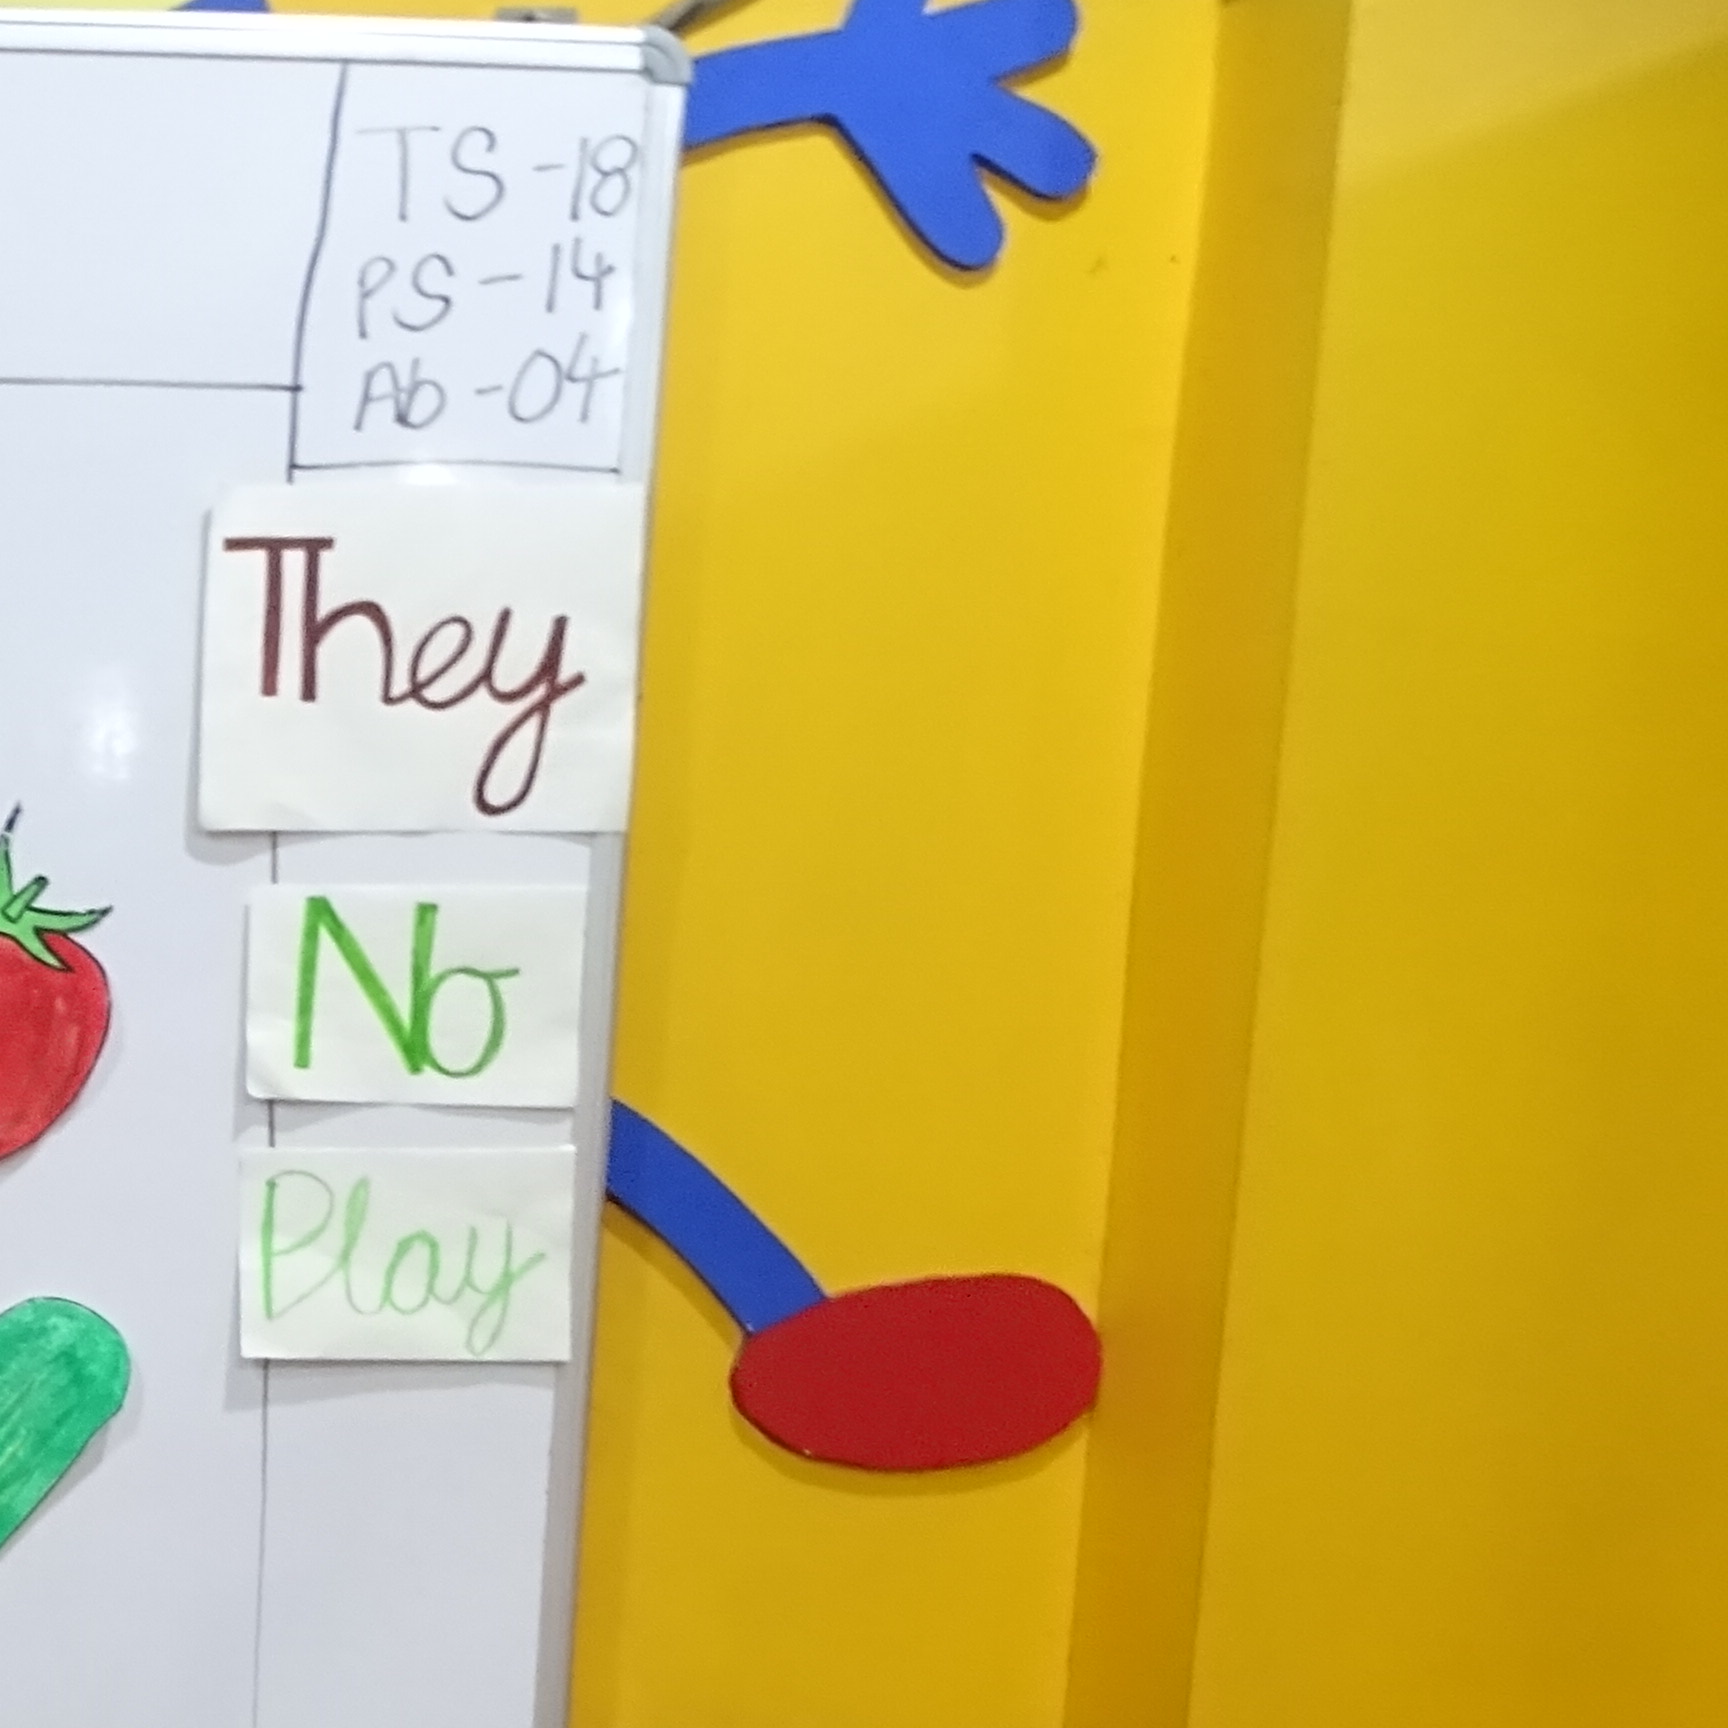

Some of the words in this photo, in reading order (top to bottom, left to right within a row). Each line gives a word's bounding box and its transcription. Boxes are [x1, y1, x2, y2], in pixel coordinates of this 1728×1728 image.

[223, 536, 586, 817] They
[293, 895, 520, 1079] No
[261, 1169, 546, 1358] Play
